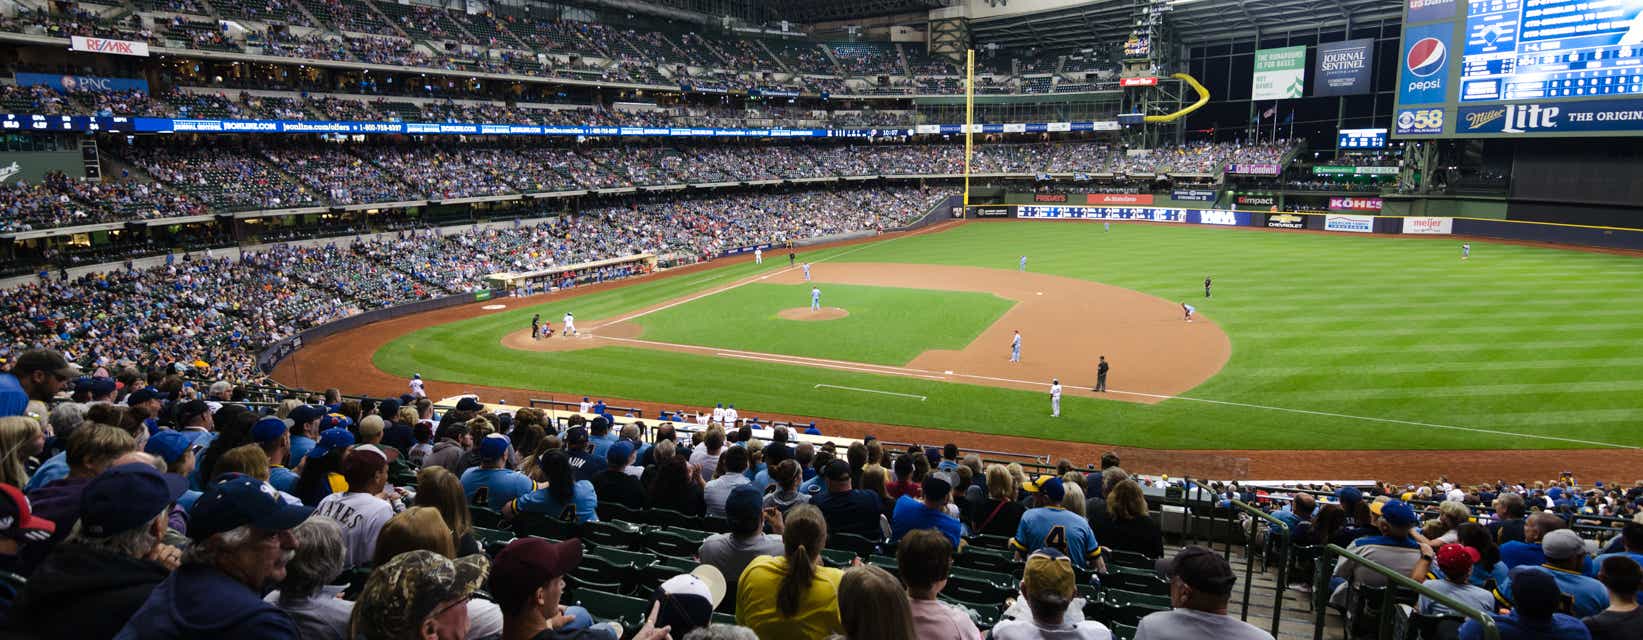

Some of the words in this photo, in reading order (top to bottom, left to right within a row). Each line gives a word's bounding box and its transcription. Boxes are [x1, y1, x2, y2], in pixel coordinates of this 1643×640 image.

[1409, 0, 1454, 9] usba
[87, 39, 133, 53] RE/MAX
[1324, 52, 1365, 63] JOURNAL
[1321, 60, 1365, 71] SENTINEL
[79, 78, 112, 90] PNC
[1408, 79, 1441, 92] pepsi
[1414, 109, 1443, 128] 58
[1466, 109, 1505, 129] Miller
[1501, 104, 1559, 133] Lite
[1568, 113, 1593, 121] THE
[1597, 111, 1643, 120] ORIGIN
[1236, 164, 1249, 173] Club
[1250, 164, 1277, 174] Goodwill
[1246, 197, 1273, 206] impact
[1045, 525, 1067, 553] 4
